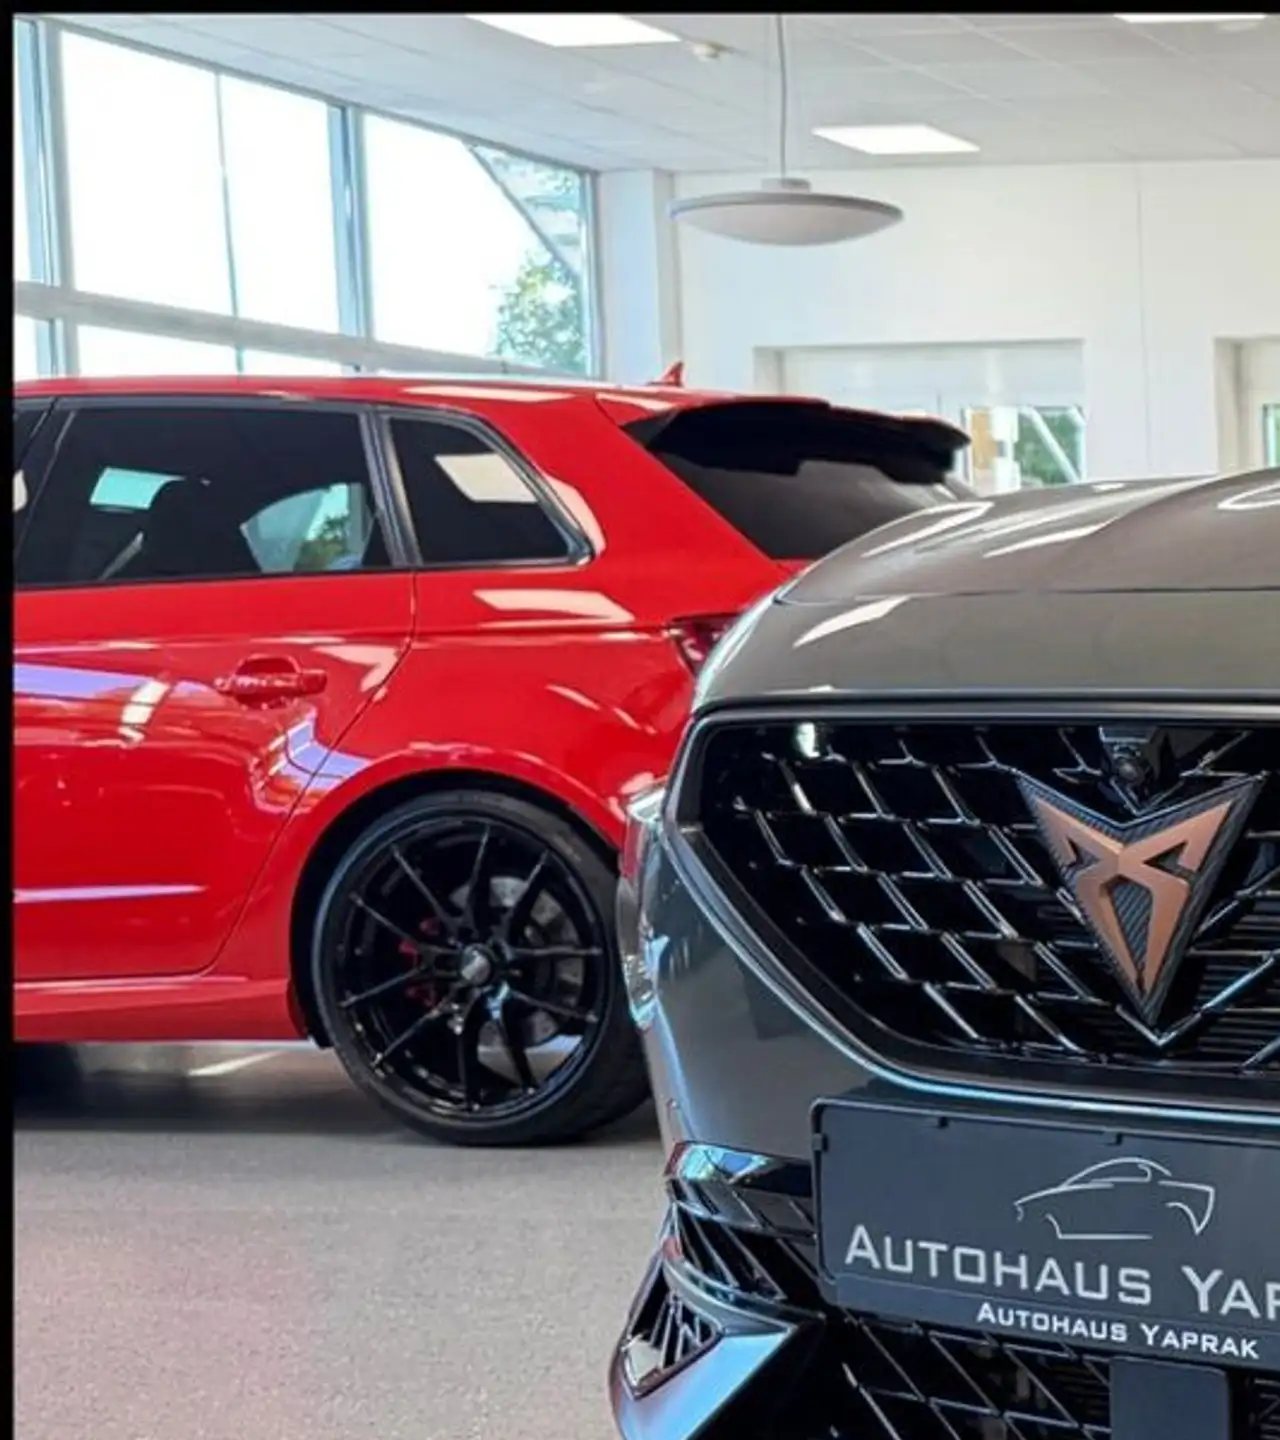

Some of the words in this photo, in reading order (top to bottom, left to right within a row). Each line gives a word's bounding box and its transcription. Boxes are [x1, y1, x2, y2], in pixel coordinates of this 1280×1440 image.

[844, 1223, 1153, 1307] AUTOHAUS
[976, 1302, 1128, 1343] AUTOHAUS
[1142, 1324, 1260, 1361] YAPRAK
